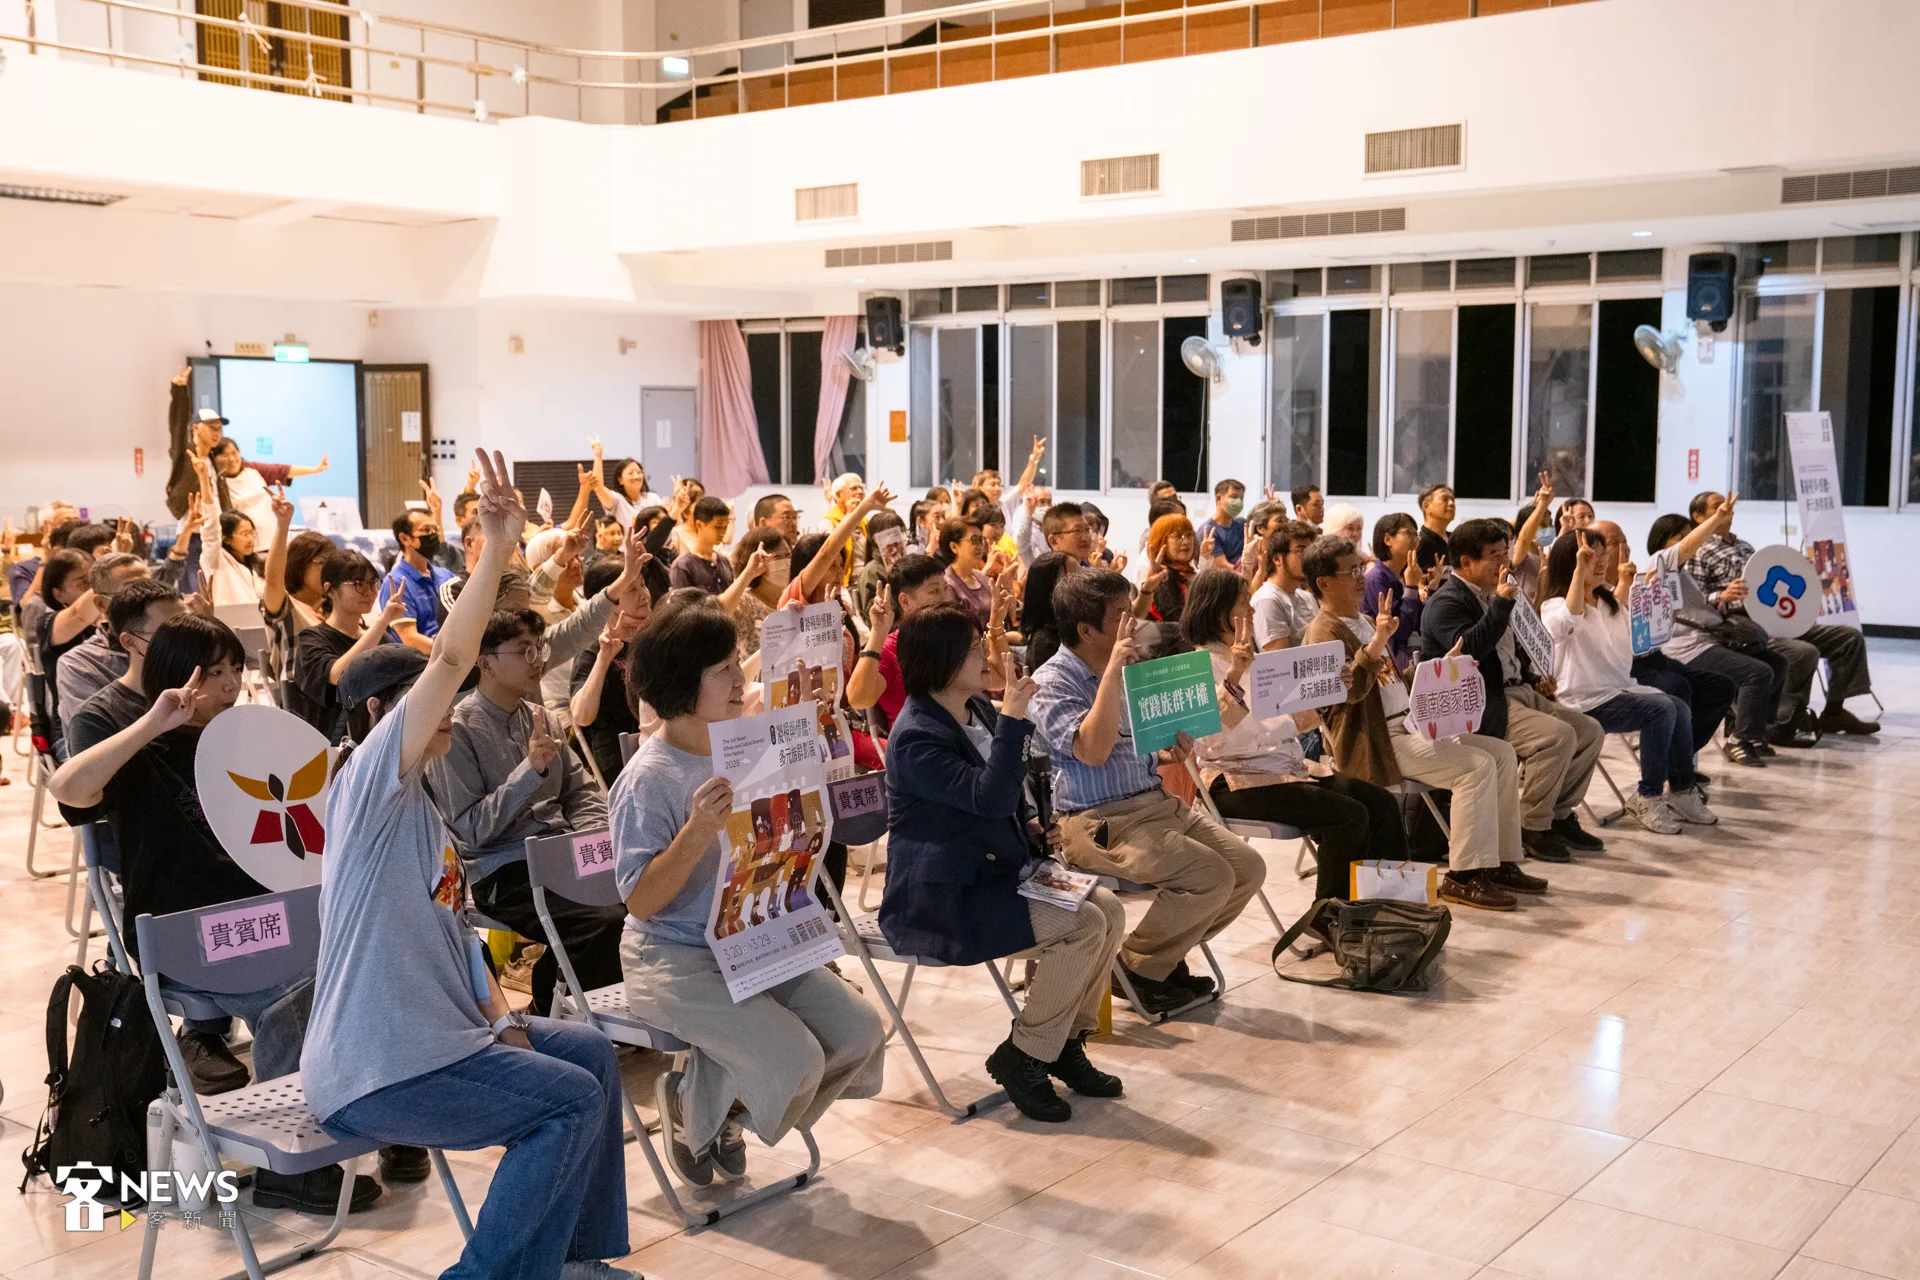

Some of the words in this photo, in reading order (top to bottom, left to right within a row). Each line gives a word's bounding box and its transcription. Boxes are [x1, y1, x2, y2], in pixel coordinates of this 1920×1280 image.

[1300, 676, 1342, 700] 多元族群影展
[1138, 682, 1210, 723] 實踐族群平權
[725, 759, 740, 770] 2026
[779, 739, 816, 768] 多元族群影展
[838, 785, 878, 812] 貴賓席
[208, 911, 283, 952] 貴賓席
[723, 944, 743, 961] 3.20
